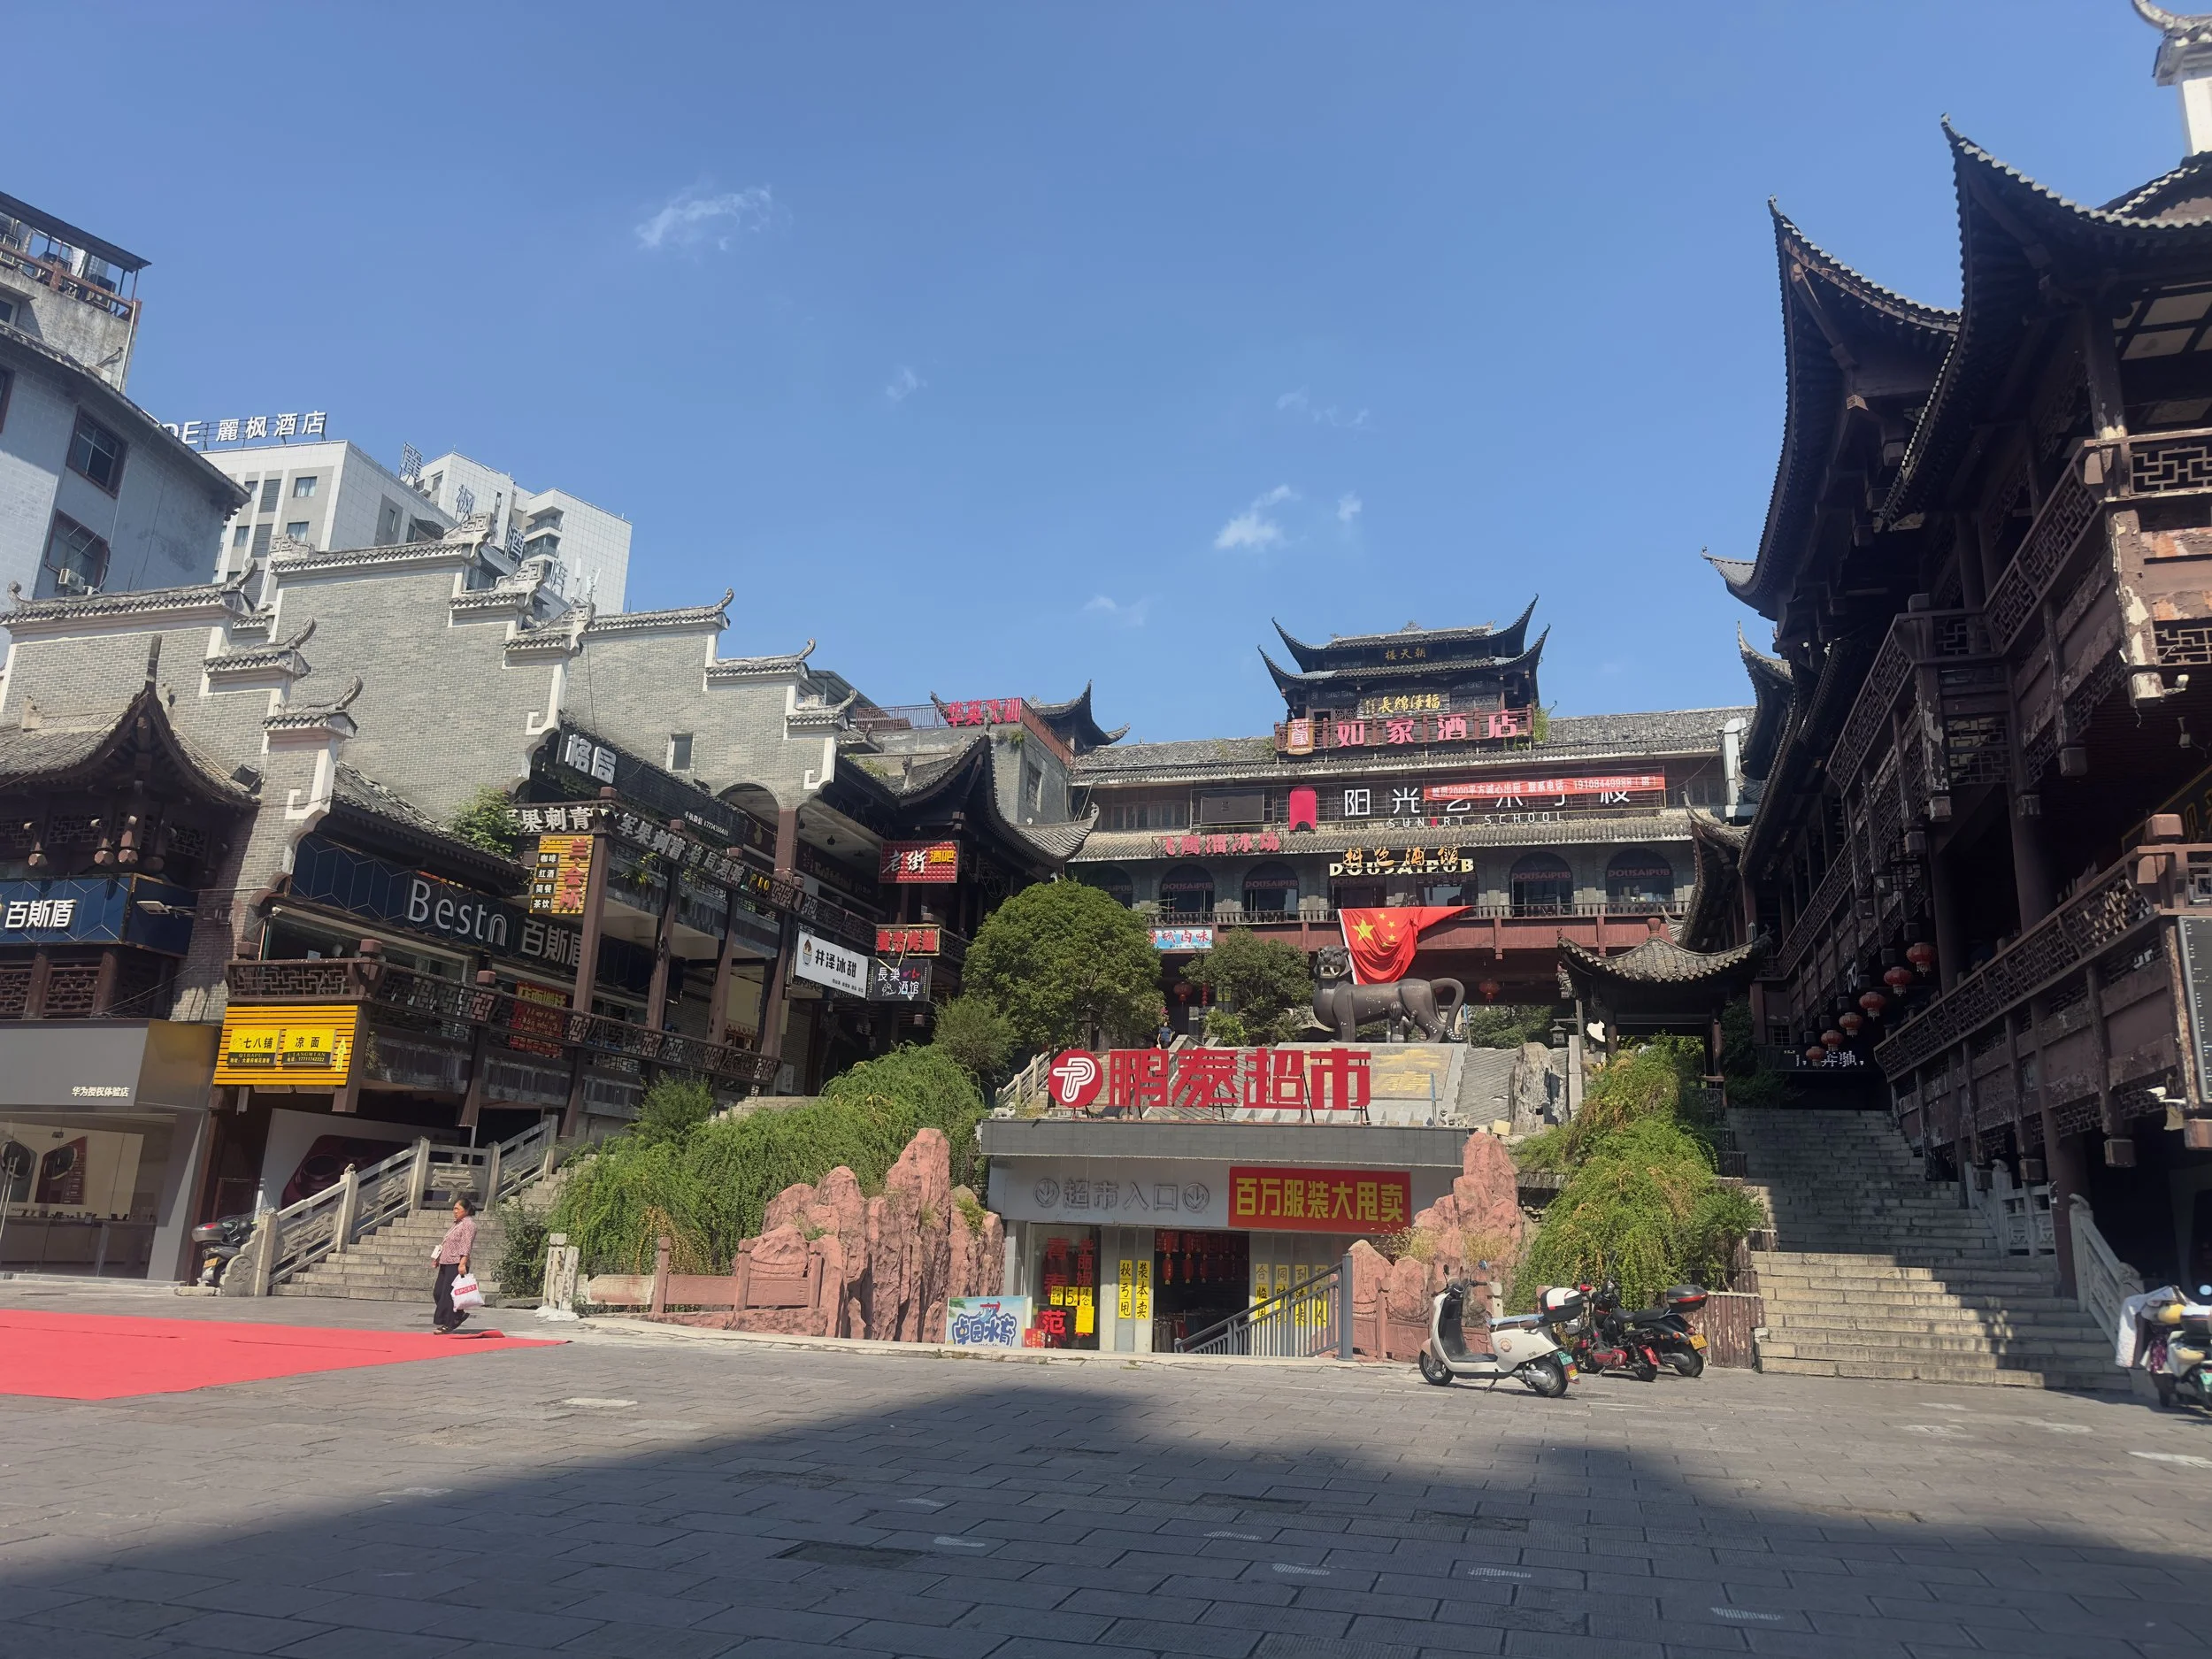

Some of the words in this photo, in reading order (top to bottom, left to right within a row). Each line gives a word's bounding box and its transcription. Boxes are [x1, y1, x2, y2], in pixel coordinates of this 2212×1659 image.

[1336, 710, 1517, 747] 如家酒店
[565, 733, 617, 784] 格局
[1485, 812, 1564, 824] SCHOOL
[930, 849, 956, 864] 酒吧
[5, 899, 77, 928] 百斯盾
[815, 949, 857, 978] 井泽冰甜
[243, 1038, 273, 1048] 七八铺
[295, 1037, 319, 1048] 凉面
[72, 1086, 130, 1097] 华为授权体验店
[1109, 1048, 1371, 1110] 鹏泰超市
[1063, 1179, 1178, 1210] 超市入口
[1235, 1177, 1405, 1223] 百万服装大甩卖
